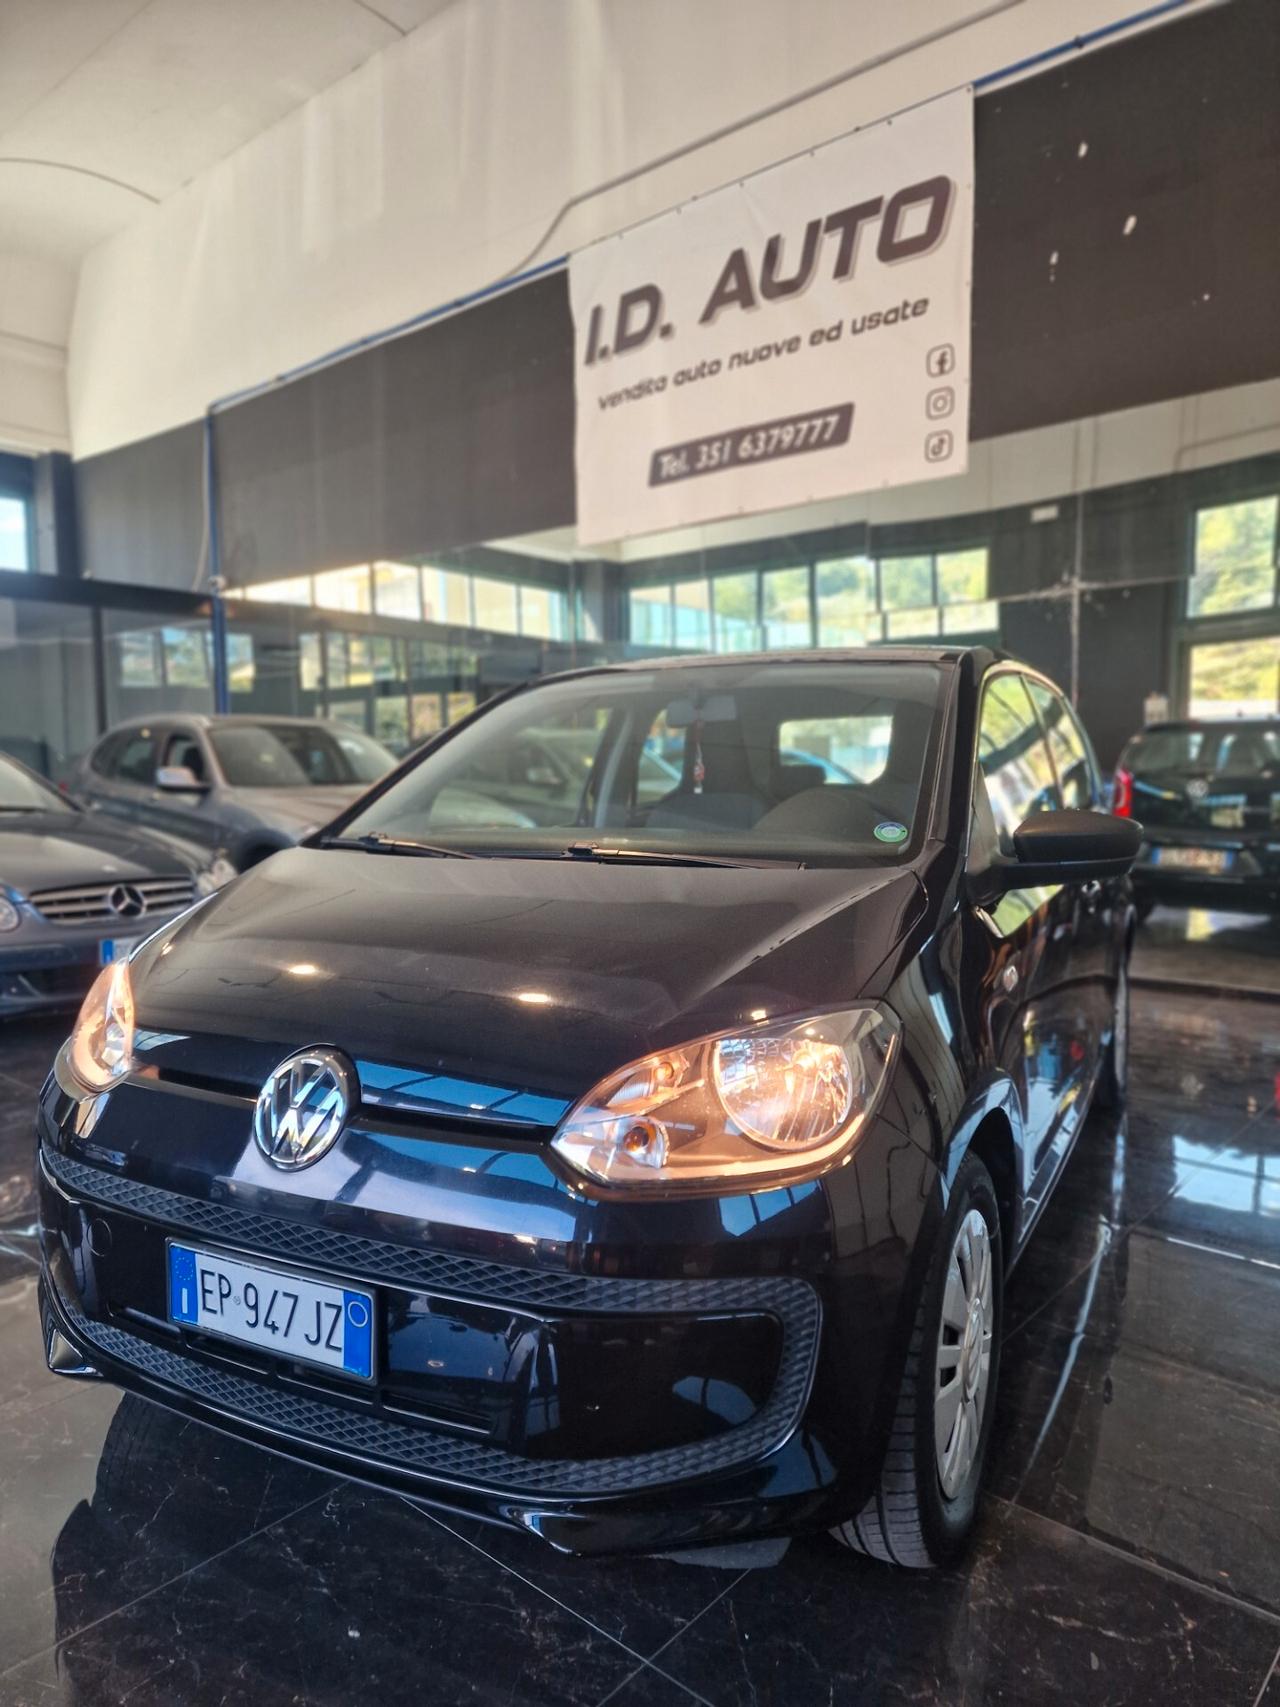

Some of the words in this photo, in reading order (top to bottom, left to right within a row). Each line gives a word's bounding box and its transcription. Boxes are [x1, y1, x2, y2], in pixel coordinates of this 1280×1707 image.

[585, 282, 674, 367] I.D.
[698, 175, 953, 325] AUTO
[673, 358, 722, 387] auto
[728, 335, 802, 371] nuove
[808, 319, 844, 347] ed
[850, 298, 929, 336] usate
[695, 437, 732, 471] 351
[738, 414, 840, 460] 6379777
[200, 1268, 232, 1317] EP
[243, 1282, 299, 1338] 947
[304, 1300, 343, 1353] JZ
